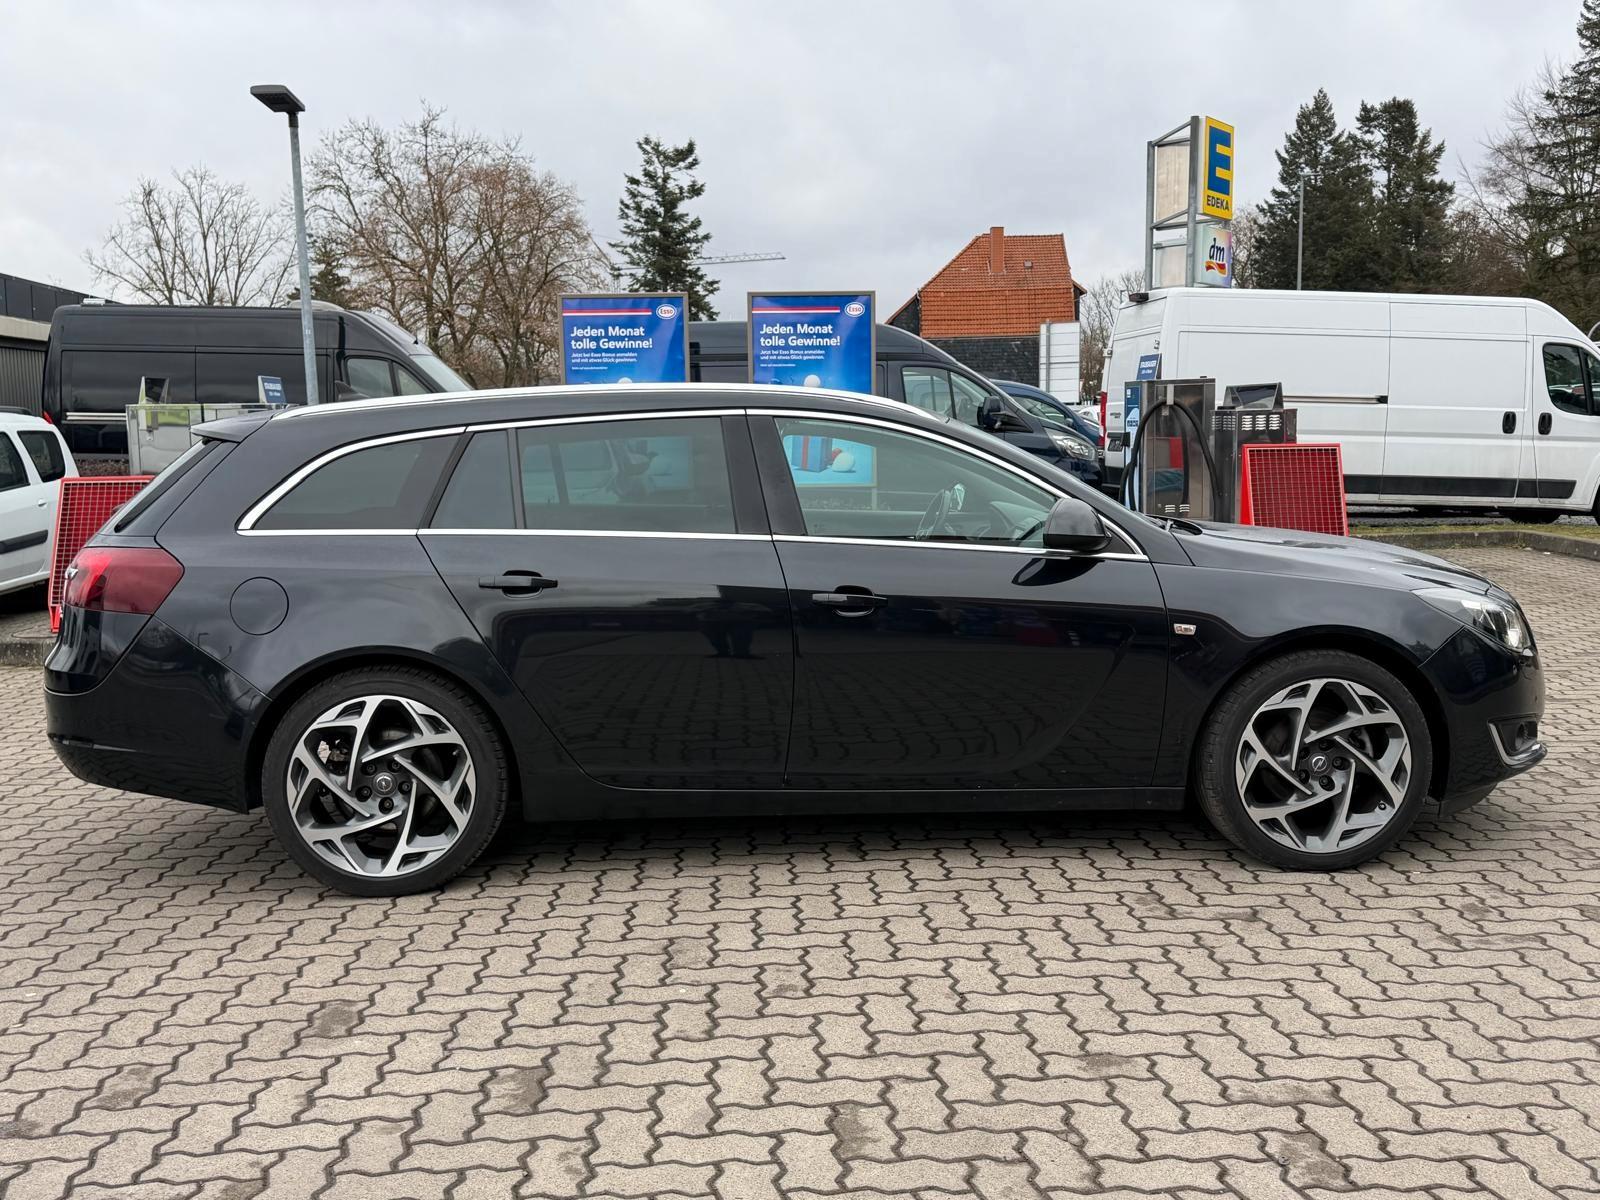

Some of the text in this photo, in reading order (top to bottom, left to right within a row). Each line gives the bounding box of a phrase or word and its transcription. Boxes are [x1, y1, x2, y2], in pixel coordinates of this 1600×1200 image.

[1206, 195, 1230, 211] EDEKA
[1208, 238, 1225, 262] dm
[571, 326, 645, 337] Jeden Monat
[760, 324, 833, 334] Jeden Monat
[571, 338, 653, 349] tolle Gewinne!
[760, 336, 841, 347] tolle Gewinne!
